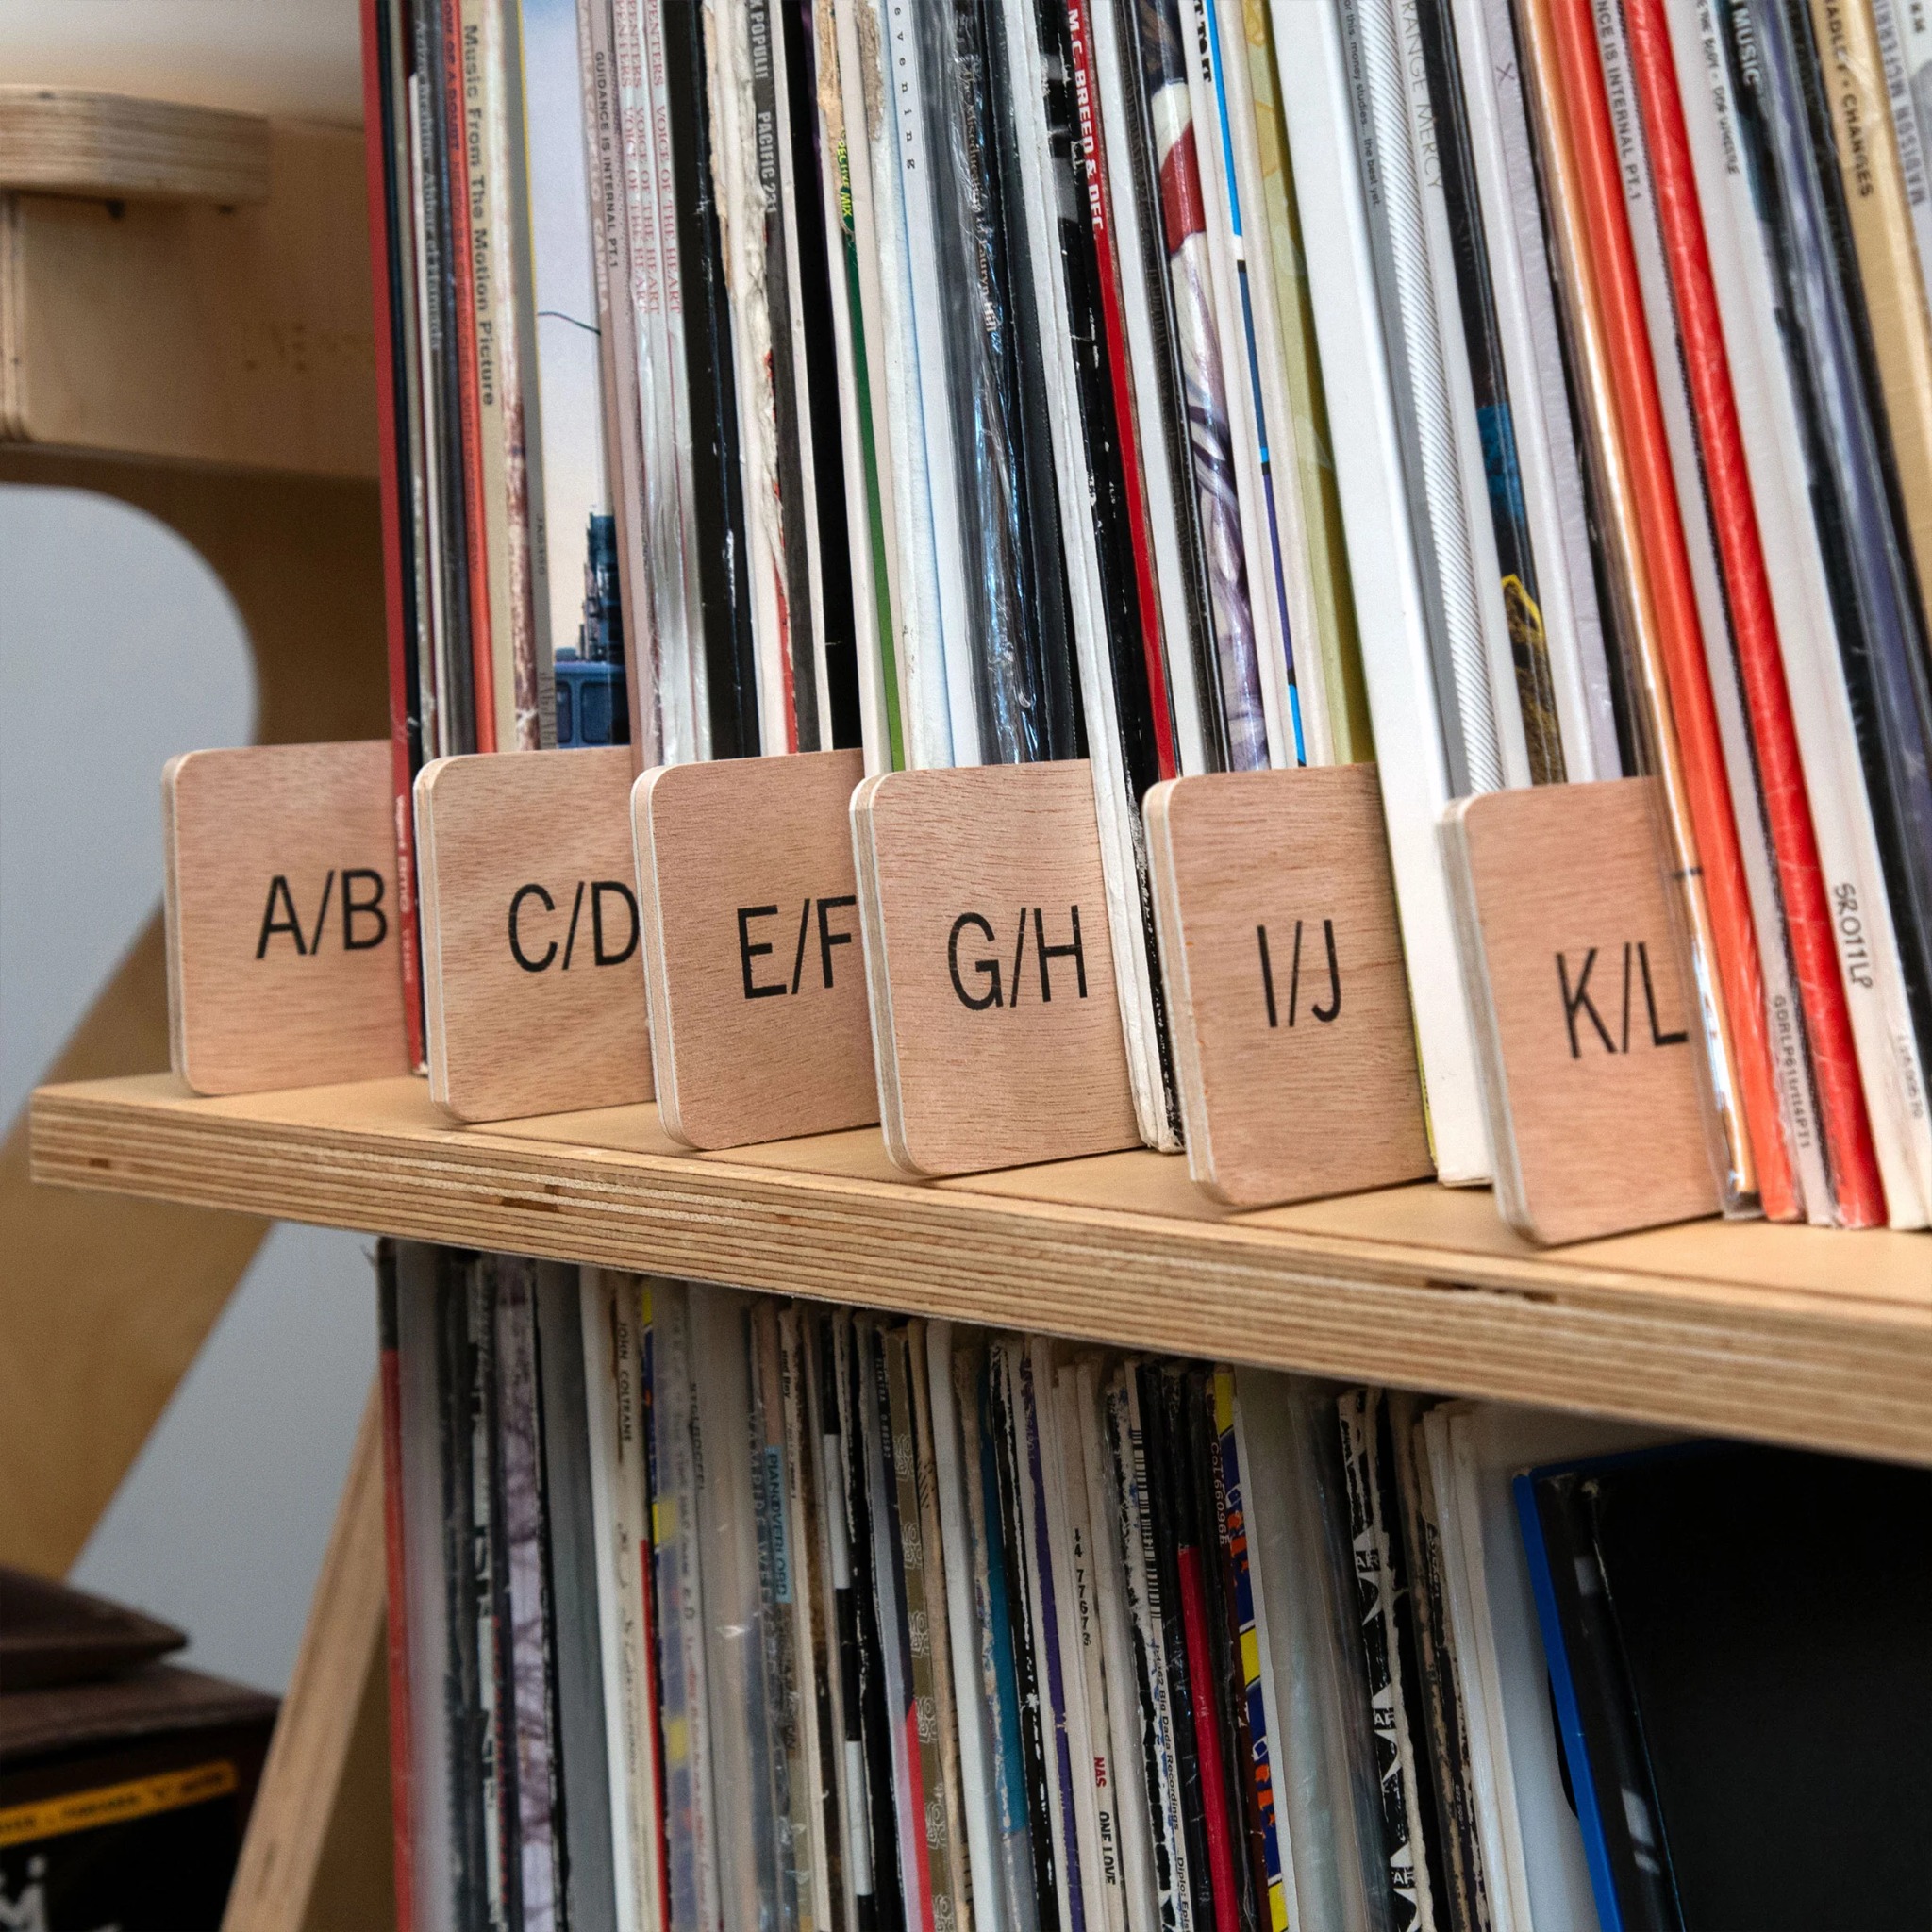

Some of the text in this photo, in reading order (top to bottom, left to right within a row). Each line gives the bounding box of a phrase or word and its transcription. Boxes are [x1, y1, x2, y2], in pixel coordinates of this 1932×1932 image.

[750, 12, 769, 78] POPULI!
[1351, 42, 1362, 79] money
[1604, 42, 1618, 61] IS
[1732, 8, 1760, 86] MUSIC
[636, 106, 648, 164] VOICE
[656, 105, 670, 163] VOICE
[758, 111, 774, 179] PACIFIC
[1075, 70, 1094, 153] BREED
[1608, 67, 1635, 158] INTERNAL
[595, 52, 619, 268] GUIDANCE IS INTERNAL PT.1
[1364, 139, 1374, 157] the
[1367, 159, 1381, 184] best
[1416, 102, 1443, 189] MERCY
[1842, 94, 1874, 198] CHANGES
[660, 169, 672, 192] OF
[840, 192, 853, 217] MIX
[1626, 164, 1642, 201] PT.1
[464, 25, 495, 406] Music From The Motion Picture
[643, 201, 656, 242] THE
[663, 200, 675, 241] THE
[646, 248, 660, 315] HEART
[666, 248, 680, 315] HEART
[256, 868, 388, 959] A/B
[508, 880, 640, 973] C/D
[736, 894, 857, 1000] E/F
[947, 903, 1090, 1012] G/H
[1256, 918, 1341, 1027] I/J
[1555, 941, 1689, 1059] K/L
[621, 1371, 632, 1441] COLTRANE
[1158, 1690, 1169, 1711] Big
[1162, 1716, 1173, 1750] Dada
[1094, 1757, 1116, 1885] NAS ONE LOVE
[1166, 1755, 1180, 1830] Recordings
[1176, 1857, 1188, 1897] Diplo:
